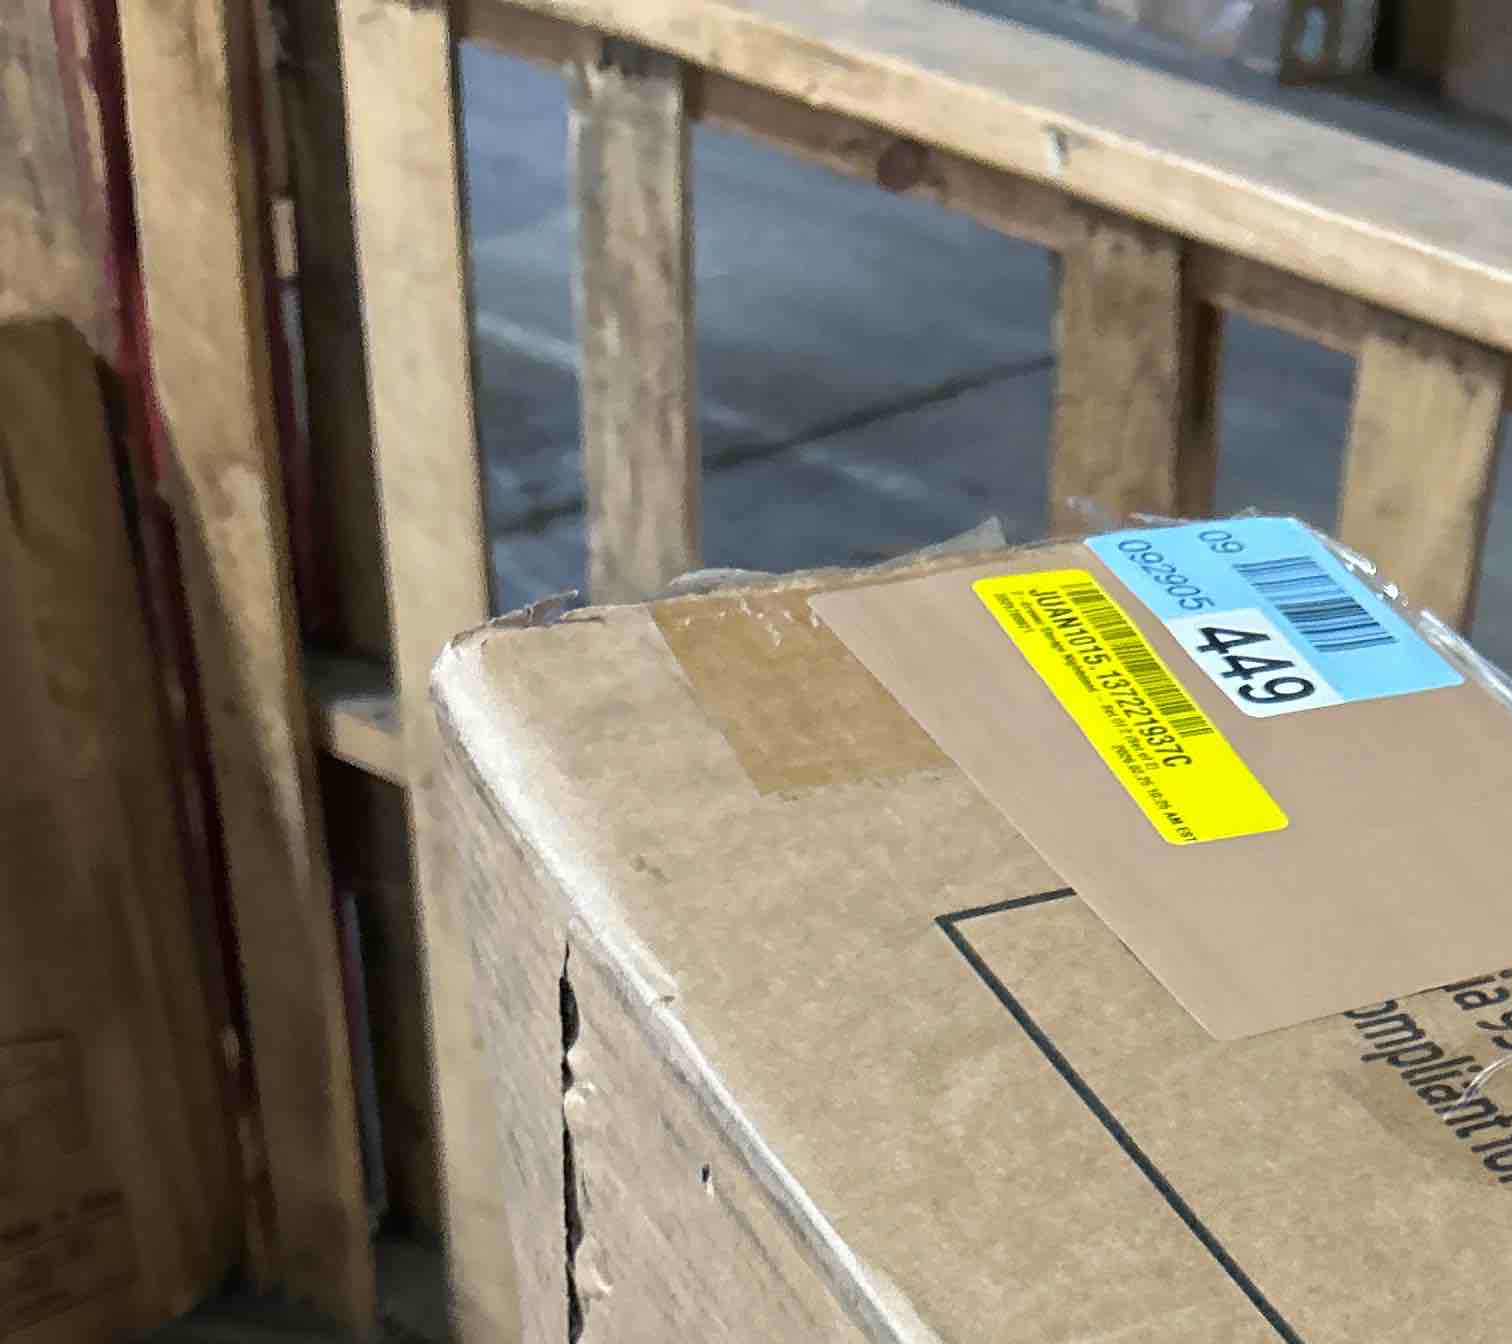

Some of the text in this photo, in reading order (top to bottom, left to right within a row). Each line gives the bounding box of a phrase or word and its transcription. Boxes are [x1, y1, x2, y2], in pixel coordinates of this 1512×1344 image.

[1116, 538, 1218, 612] 092905
[1198, 529, 1248, 557] 09
[1196, 623, 1317, 707] 449
